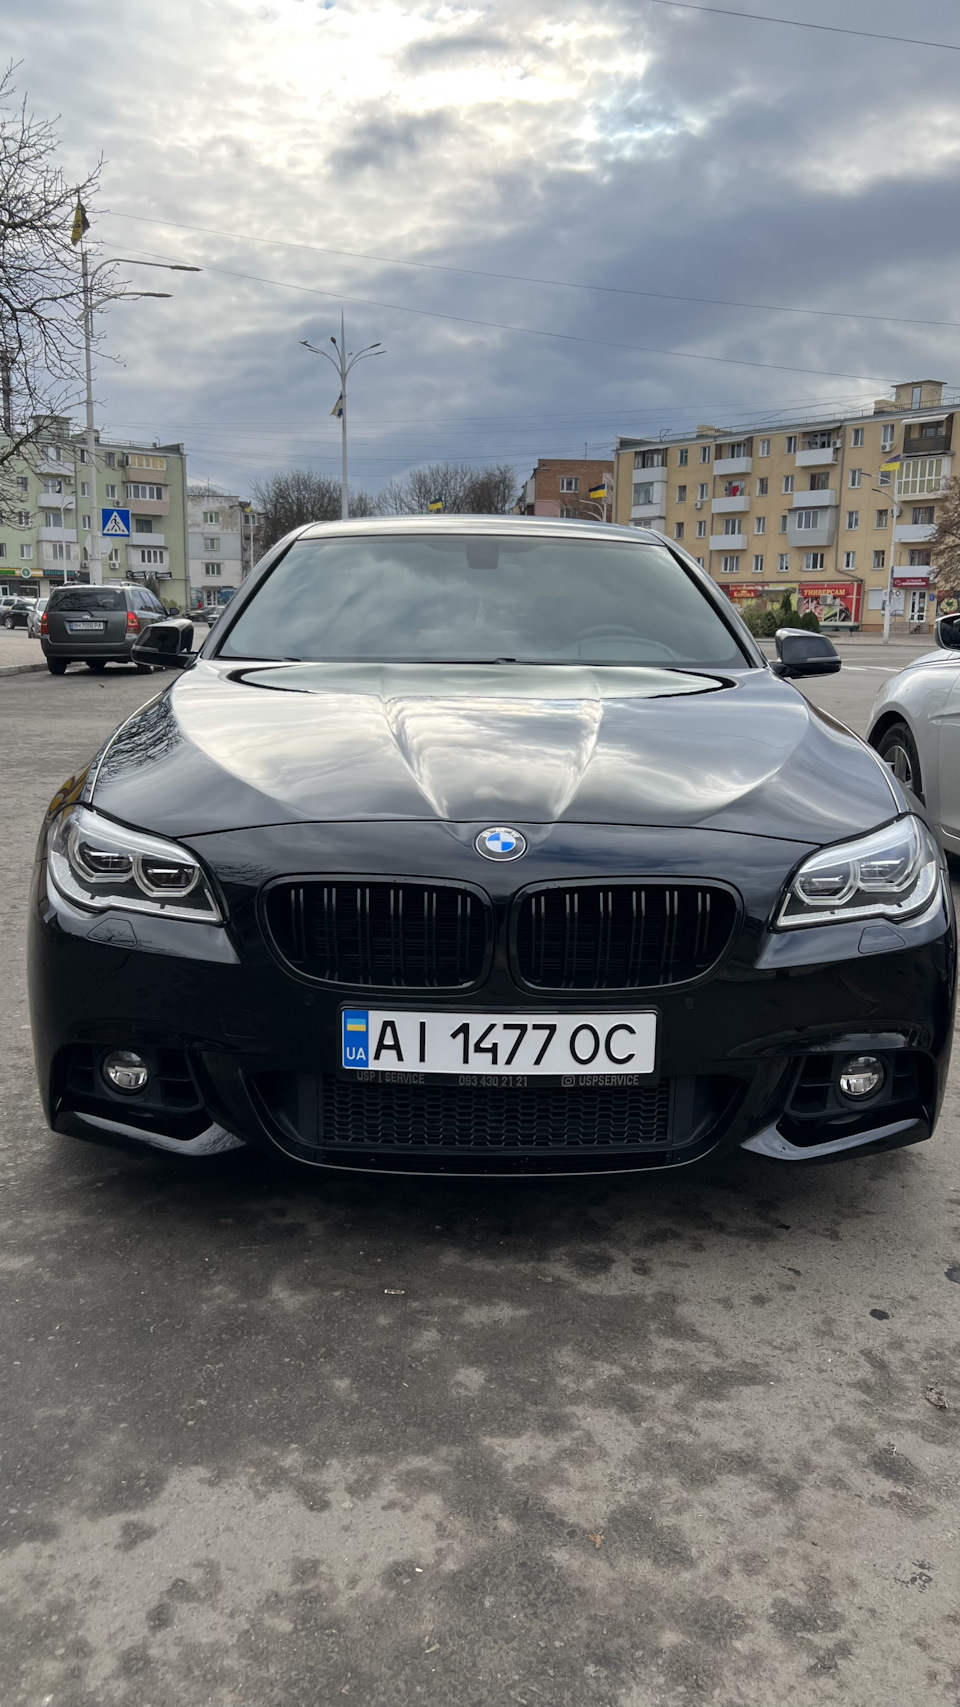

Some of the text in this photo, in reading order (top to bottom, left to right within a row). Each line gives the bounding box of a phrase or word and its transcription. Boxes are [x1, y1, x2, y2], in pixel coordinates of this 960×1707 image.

[803, 588, 846, 596] УНИВЕРСАМ
[481, 828, 521, 838] BMW
[373, 1020, 637, 1065] AI 1477 OC
[346, 1047, 367, 1060] UA
[357, 1071, 375, 1080] USP
[385, 1072, 425, 1084] SERVICE
[459, 1075, 528, 1087] 093 430 21 21
[579, 1075, 639, 1086] USPSERVICE
